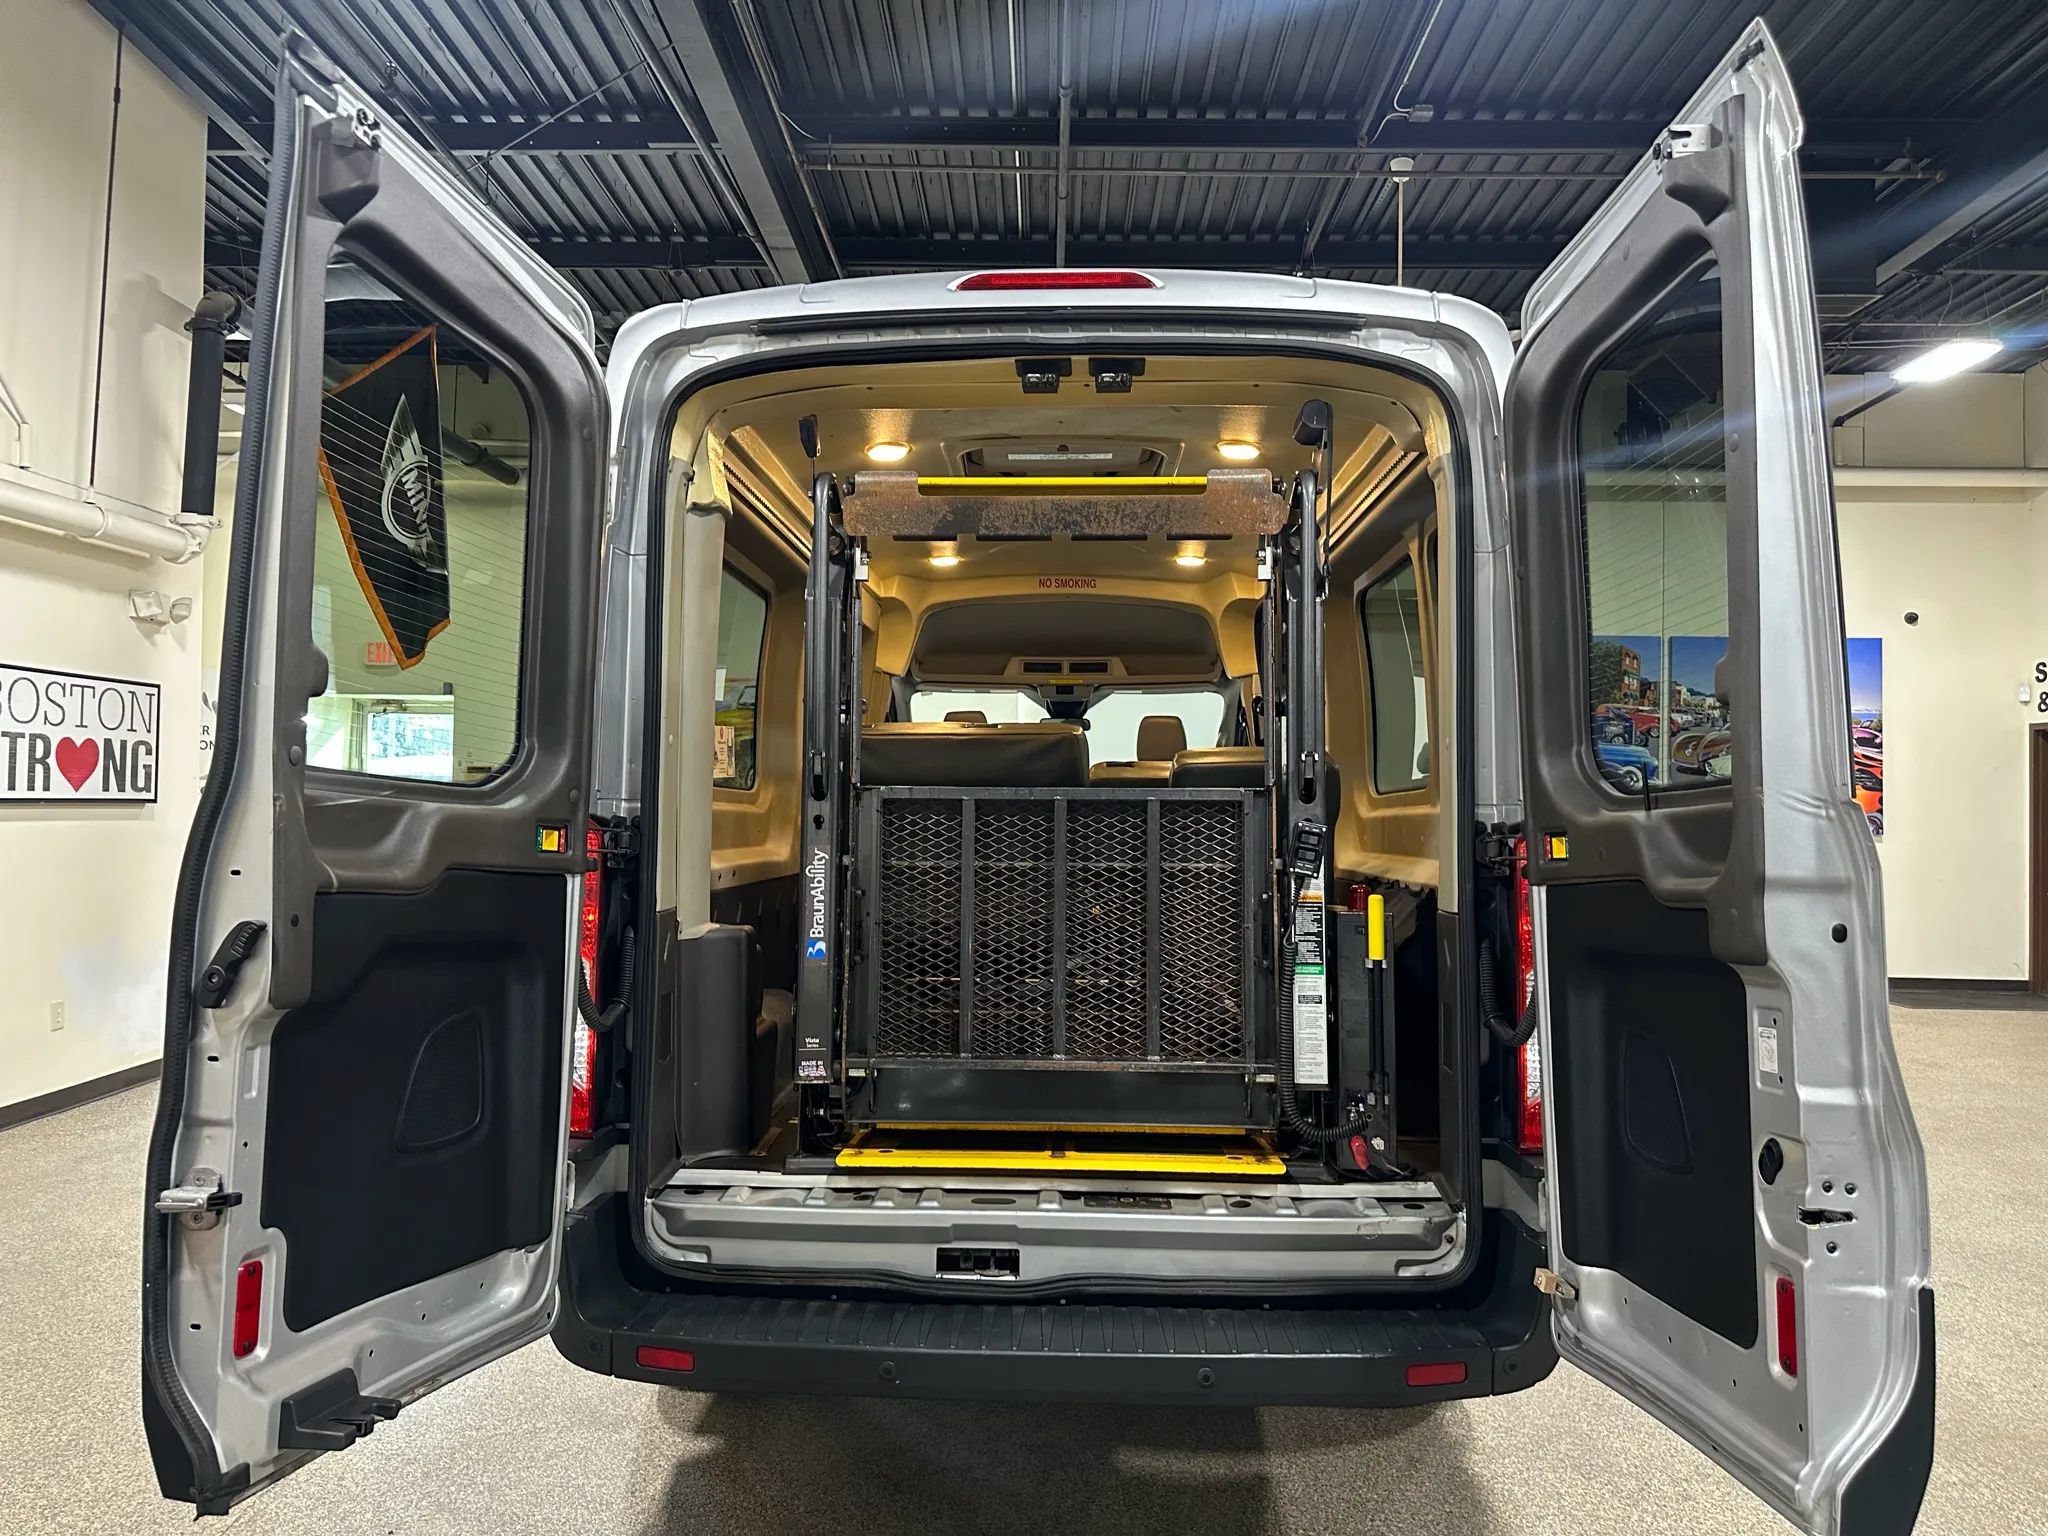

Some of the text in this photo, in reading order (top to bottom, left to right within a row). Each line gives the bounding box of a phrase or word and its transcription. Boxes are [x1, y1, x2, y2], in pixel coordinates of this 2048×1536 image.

[1039, 577, 1097, 589] NO SMOKING
[0, 676, 155, 733] OSTON
[805, 847, 829, 938] BraunAbility
